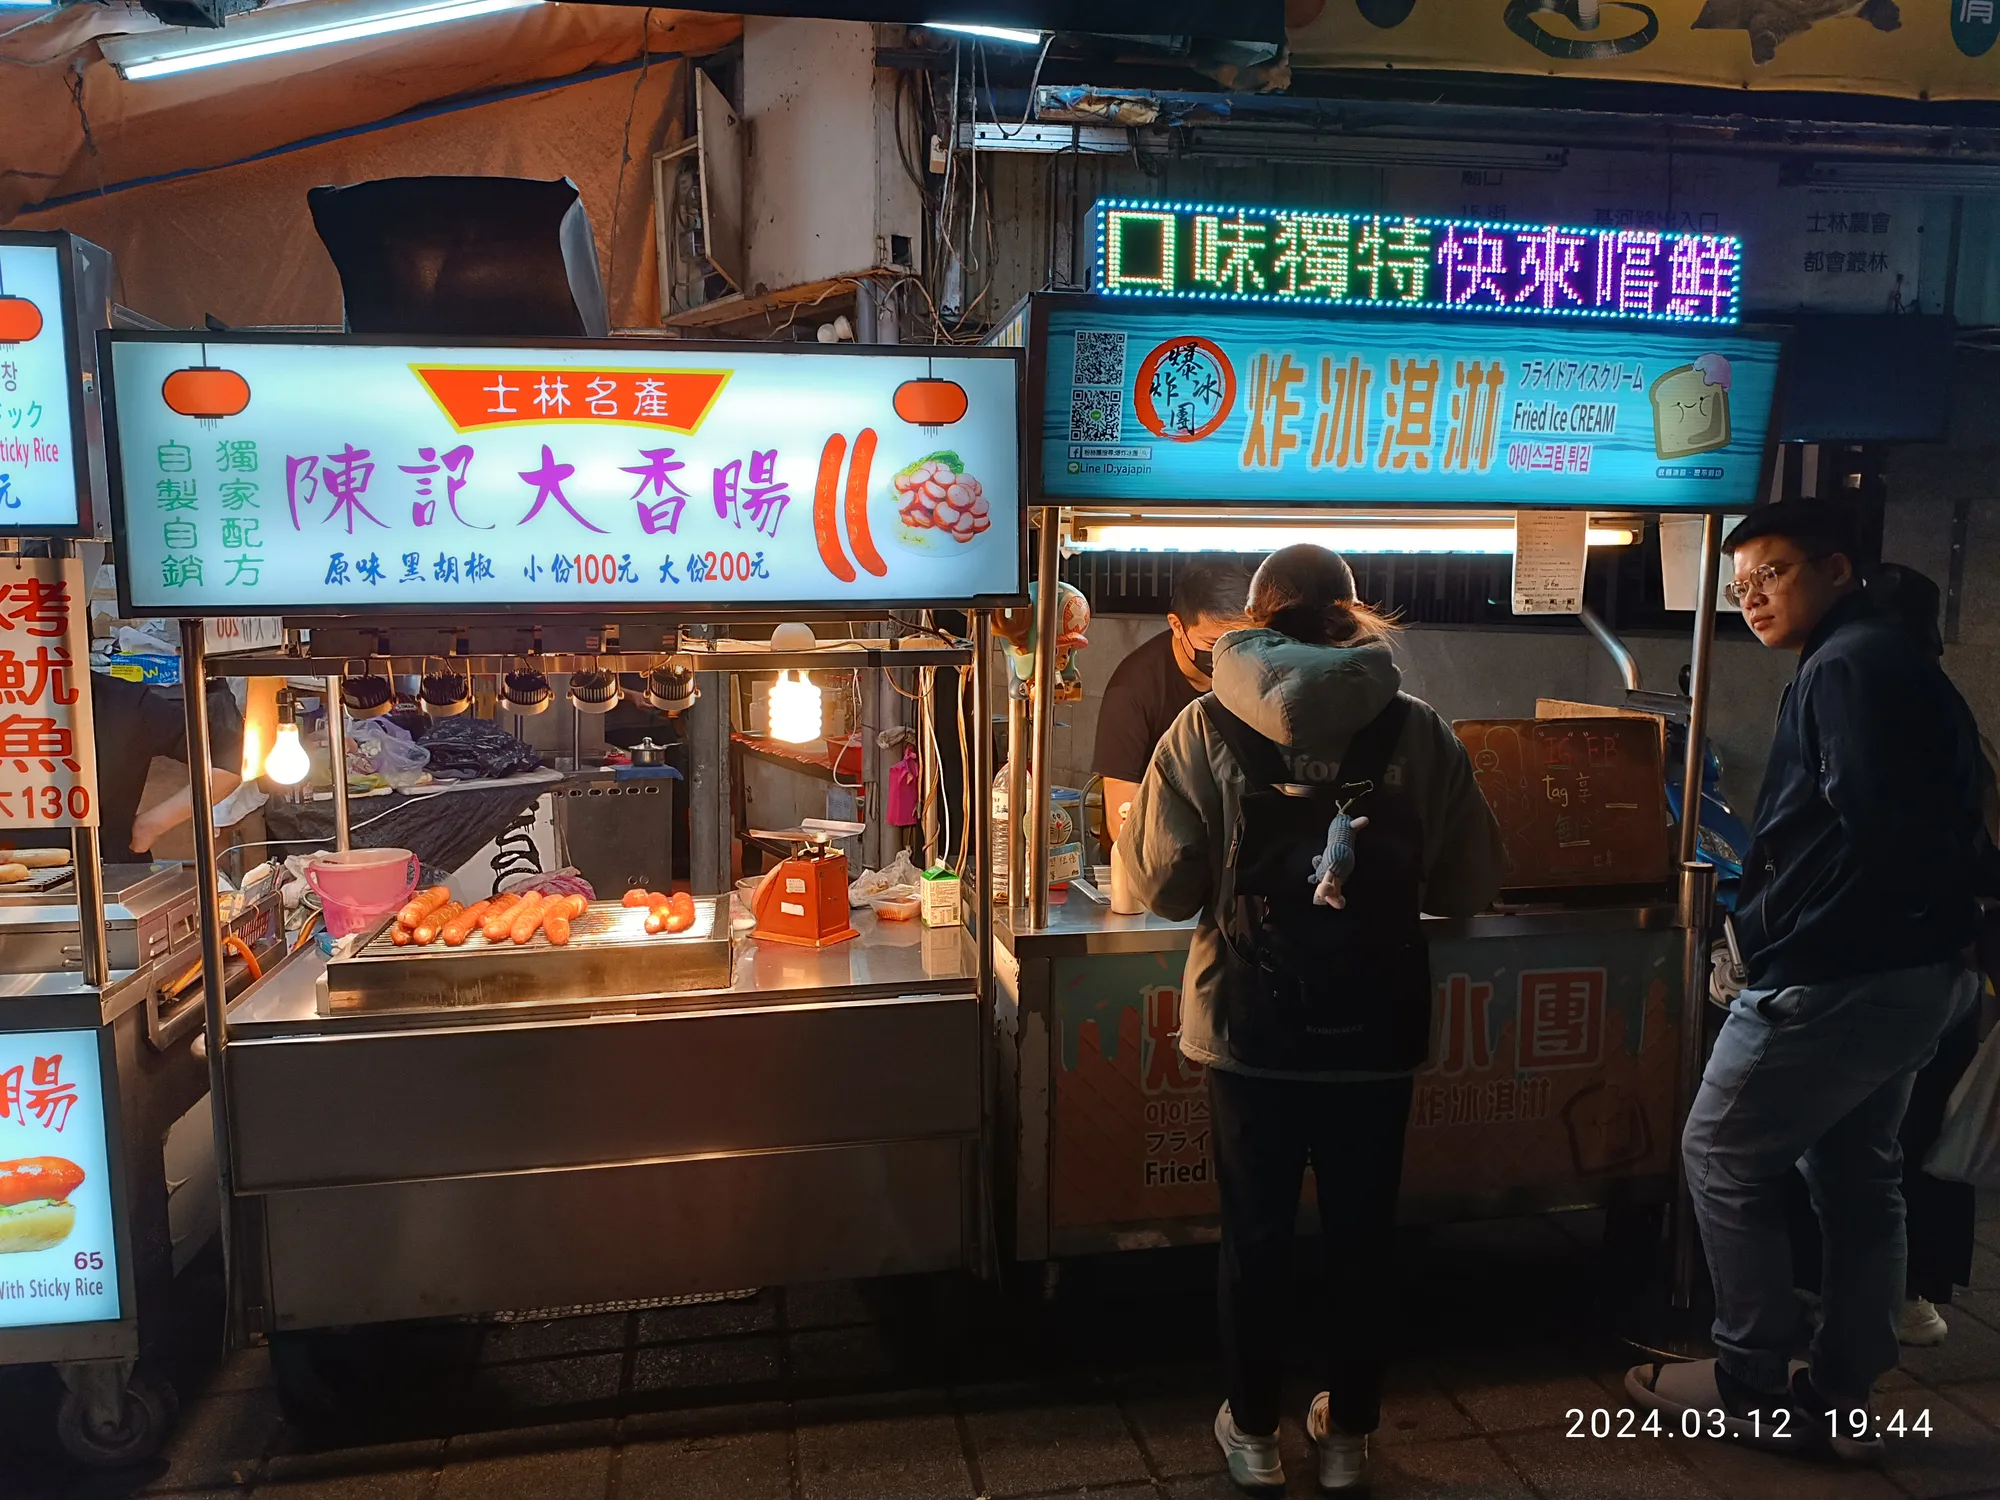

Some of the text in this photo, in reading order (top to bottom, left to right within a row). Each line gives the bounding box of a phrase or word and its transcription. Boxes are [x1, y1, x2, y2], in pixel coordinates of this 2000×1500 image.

[1806, 210, 1892, 234] 士林農會
[1803, 250, 1889, 274] 都會叢林
[1519, 360, 1644, 391] フライドアイスクリーム
[482, 374, 669, 418] 士林名產
[1241, 351, 1506, 472] 炸冰淇淋
[0, 399, 43, 430] ック
[1513, 401, 1616, 433] Fried Ice CREAM
[33, 437, 59, 463] Rice
[1508, 443, 1592, 472] 아이스크림 튀김
[1080, 463, 1101, 474] Line
[285, 442, 791, 538] 陳記大香腸
[156, 438, 204, 588] 自製自銷
[215, 439, 265, 587] 獨家配方
[324, 550, 770, 587] 原味 黑胡椒 小份100元 大份200元
[1413, 1077, 1551, 1128] 炸冰淇淋
[1145, 1157, 1207, 1186] Fried
[74, 1251, 104, 1271] 65
[30, 1278, 71, 1302] Sticky
[76, 1277, 104, 1297] Rice
